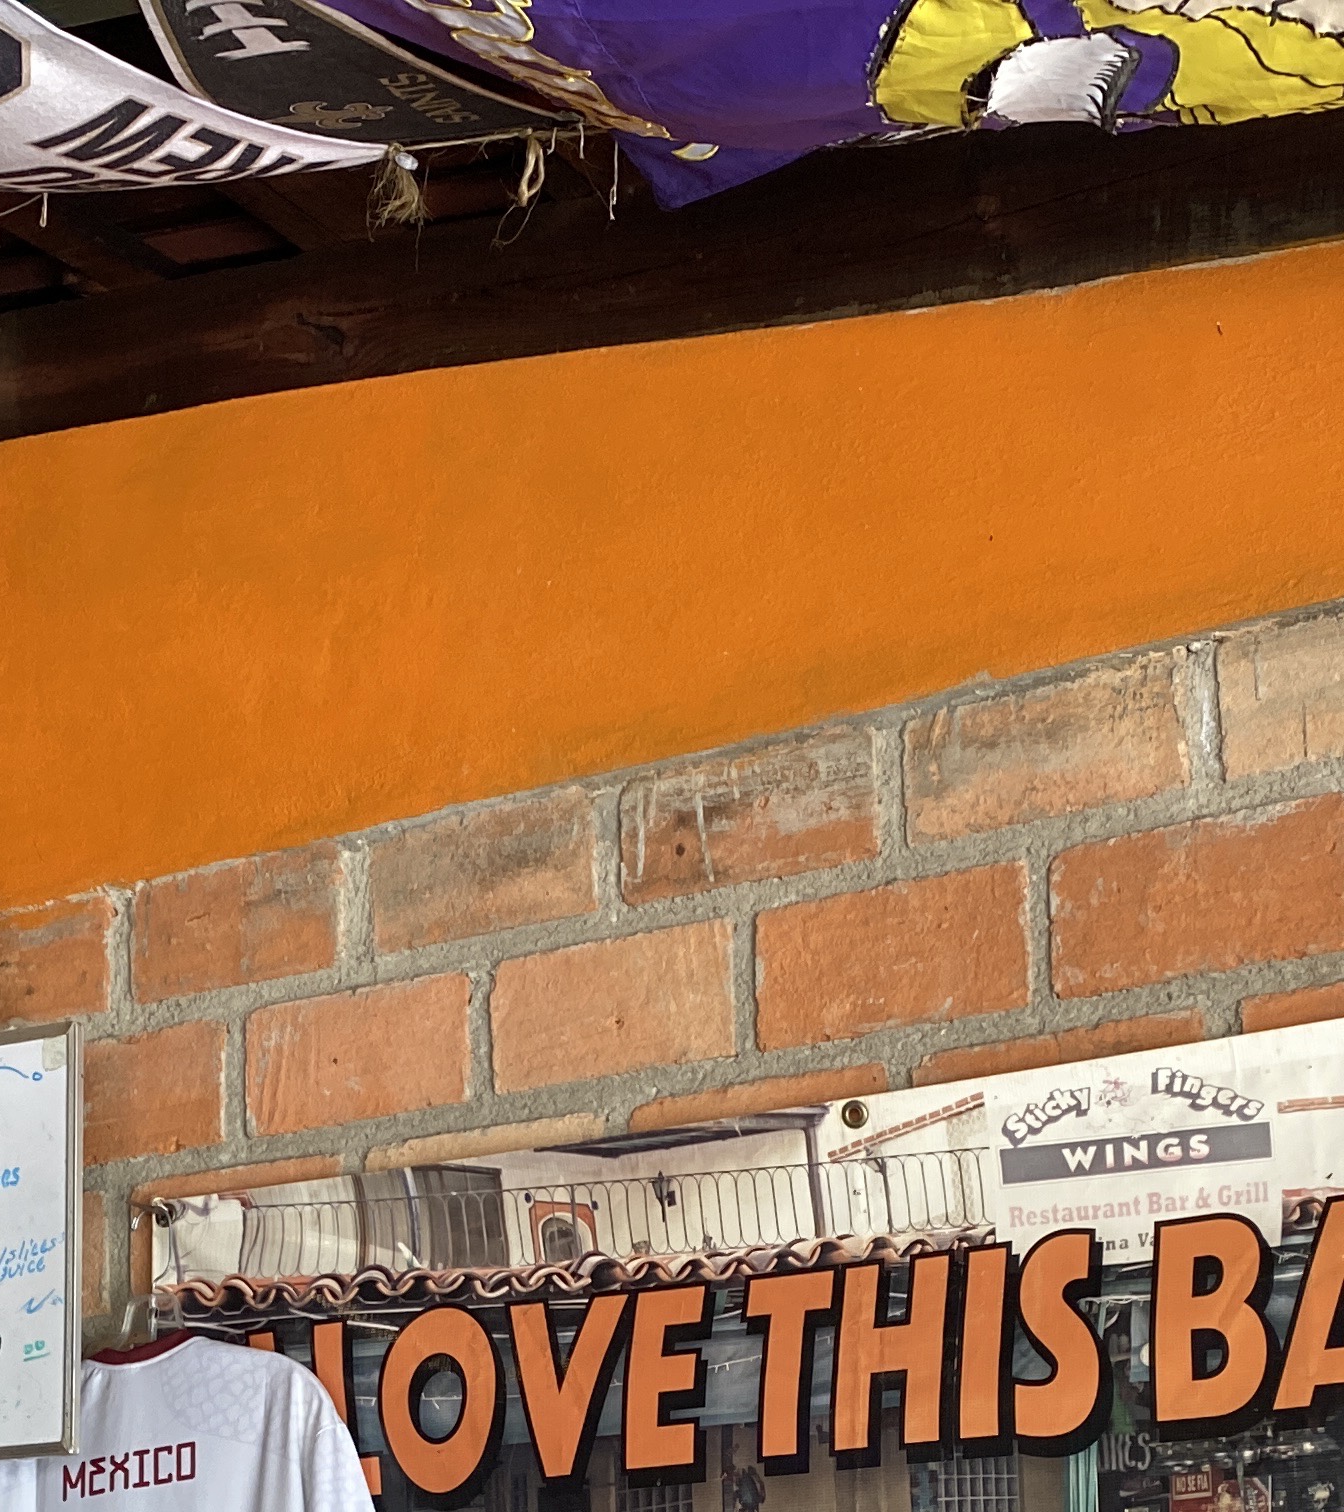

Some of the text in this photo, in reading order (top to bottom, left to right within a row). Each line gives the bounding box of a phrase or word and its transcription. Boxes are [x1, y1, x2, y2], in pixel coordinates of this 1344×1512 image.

[1002, 1068, 1264, 1148] Sticky Fingers
[1062, 1134, 1210, 1172] WINGS
[1009, 1181, 1268, 1228] Restaurant Bar & Grill
[744, 1231, 1104, 1460] THIS
[62, 1441, 196, 1502] MEXICO
[1176, 1478, 1186, 1492] NO
[1188, 1476, 1195, 1491] SE
